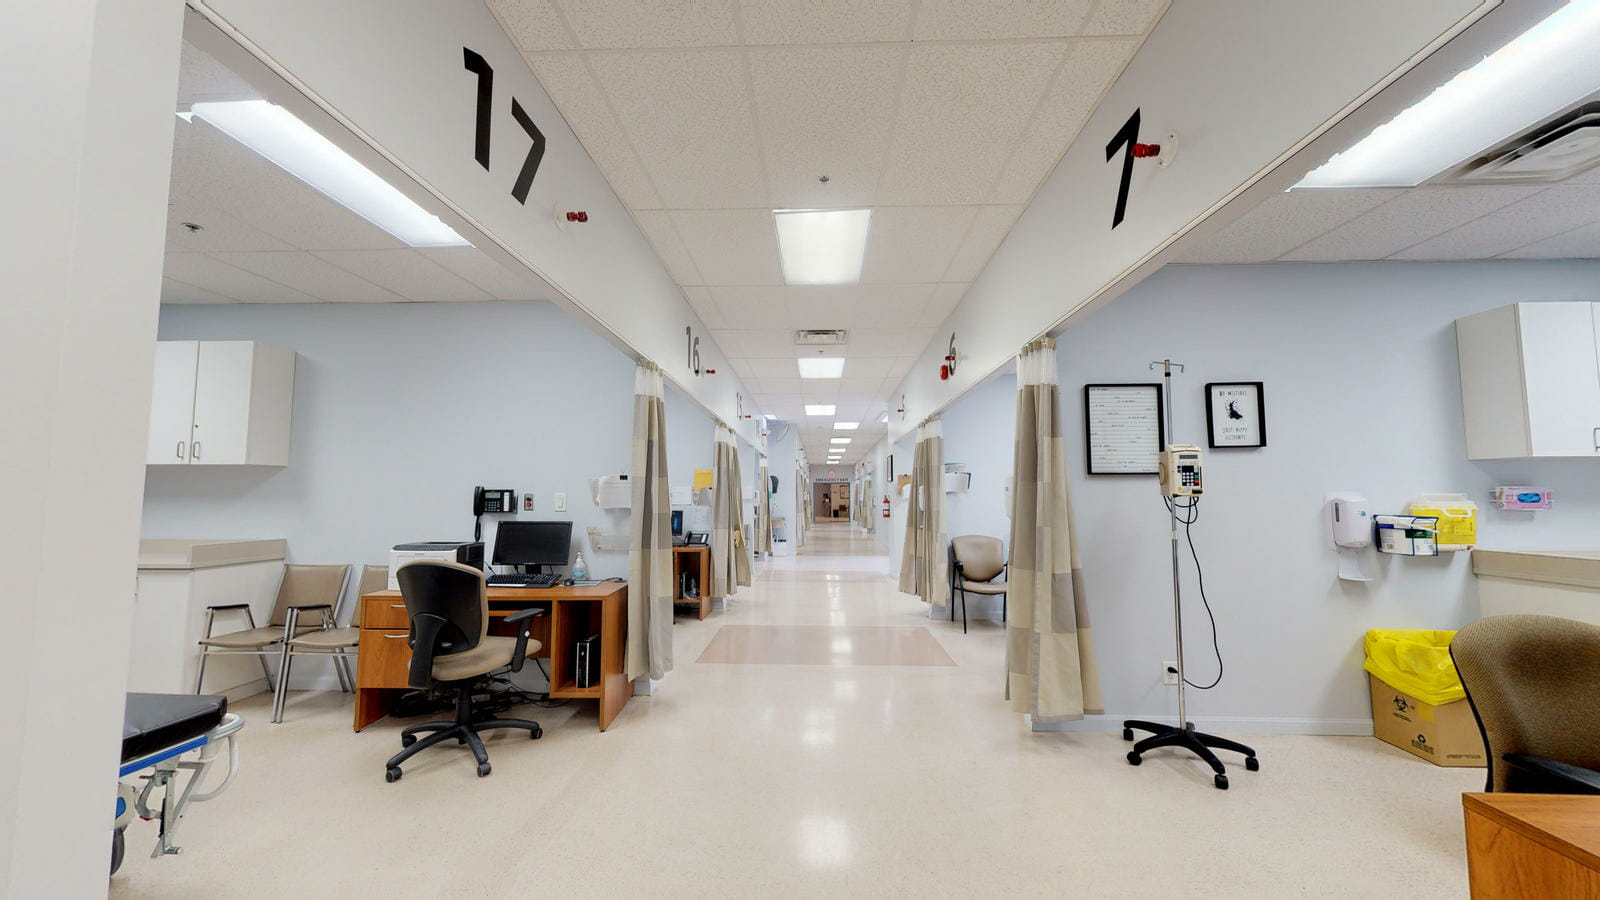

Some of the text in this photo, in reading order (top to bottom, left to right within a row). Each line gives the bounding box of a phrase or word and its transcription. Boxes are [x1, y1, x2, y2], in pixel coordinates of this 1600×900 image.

[463, 46, 546, 206] 17
[1105, 106, 1141, 230] 7
[686, 326, 700, 376] 16
[949, 331, 956, 376] 6
